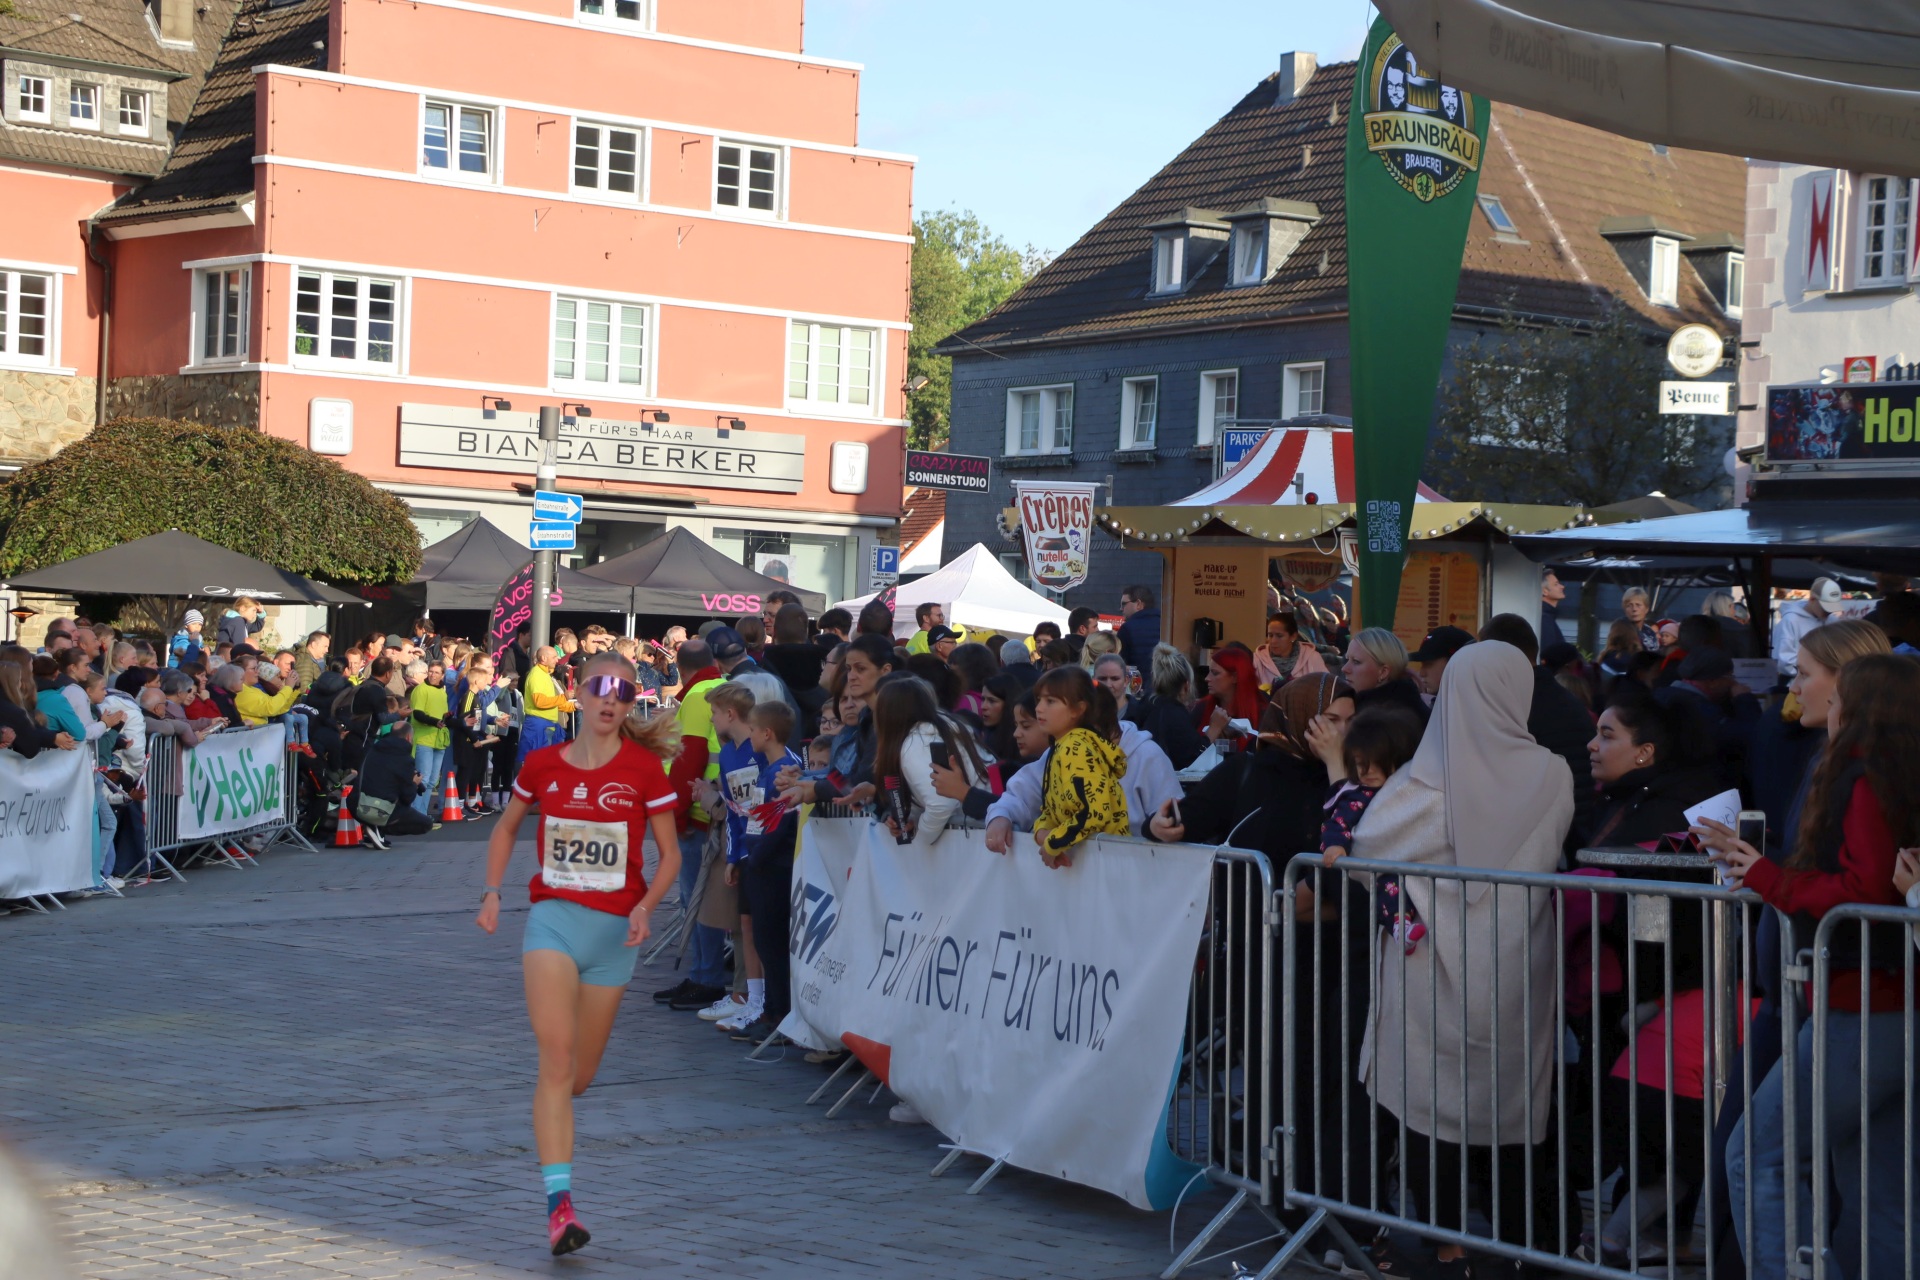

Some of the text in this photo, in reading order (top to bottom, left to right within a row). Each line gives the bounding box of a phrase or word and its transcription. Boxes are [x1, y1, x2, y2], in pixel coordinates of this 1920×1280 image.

[1370, 119, 1475, 161] BRAUNBRÄU
[1405, 153, 1442, 176] BRAUEREI
[1667, 388, 1720, 406] Penne
[648, 427, 693, 441] HAAR
[458, 431, 756, 474] BIANCA BERKER
[909, 454, 988, 474] CRAZY SUN
[908, 470, 987, 488] SONNENSTUDIO
[1021, 491, 1091, 534] Crêpes
[881, 551, 893, 569] P
[1037, 549, 1069, 563] nutella
[504, 579, 534, 607] VOS
[701, 593, 761, 613] VOSS
[491, 604, 532, 639] VOSS
[206, 747, 280, 822] Helios
[619, 798, 633, 807] Sieg
[553, 838, 619, 867] 5290
[981, 926, 1051, 1031] Für
[1053, 959, 1119, 1052] uns.
